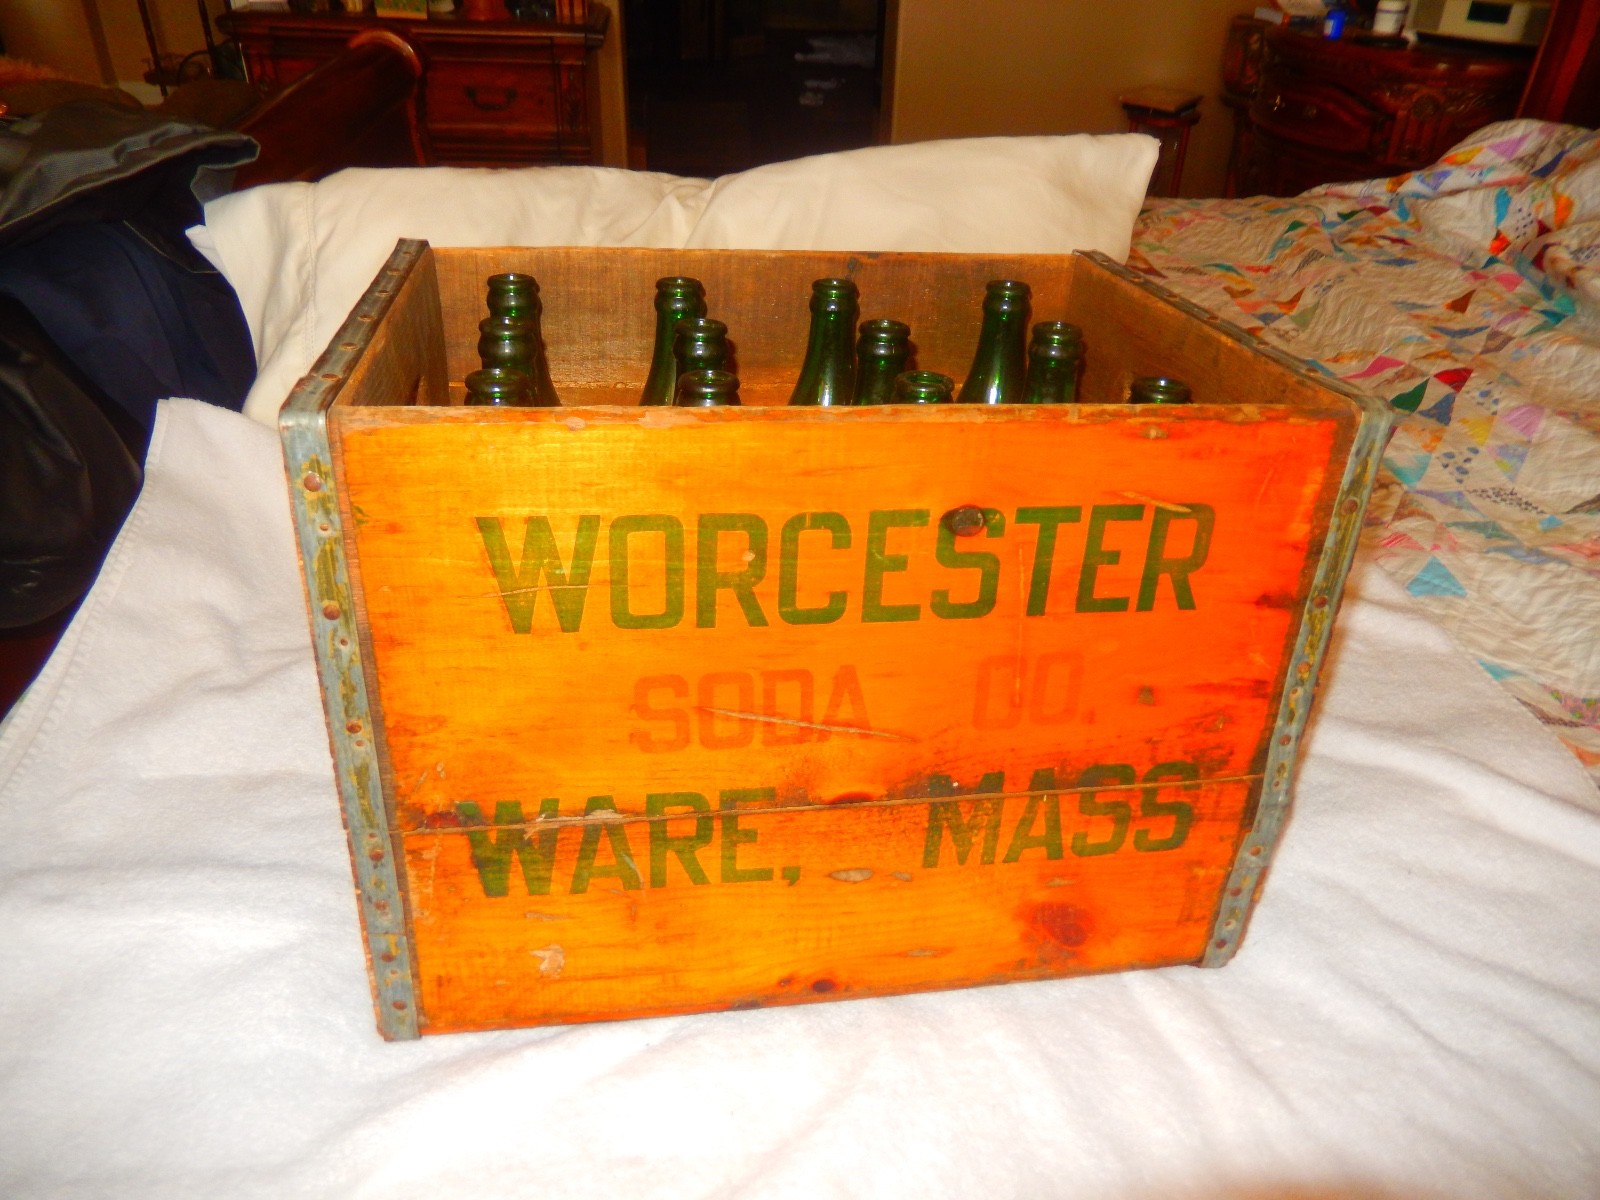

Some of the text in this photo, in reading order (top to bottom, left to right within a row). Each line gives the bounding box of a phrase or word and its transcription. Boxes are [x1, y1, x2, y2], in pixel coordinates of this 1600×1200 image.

[475, 503, 1215, 634] WORCESTER
[629, 665, 871, 753] SODA
[455, 761, 1199, 898] WARE, MASS
